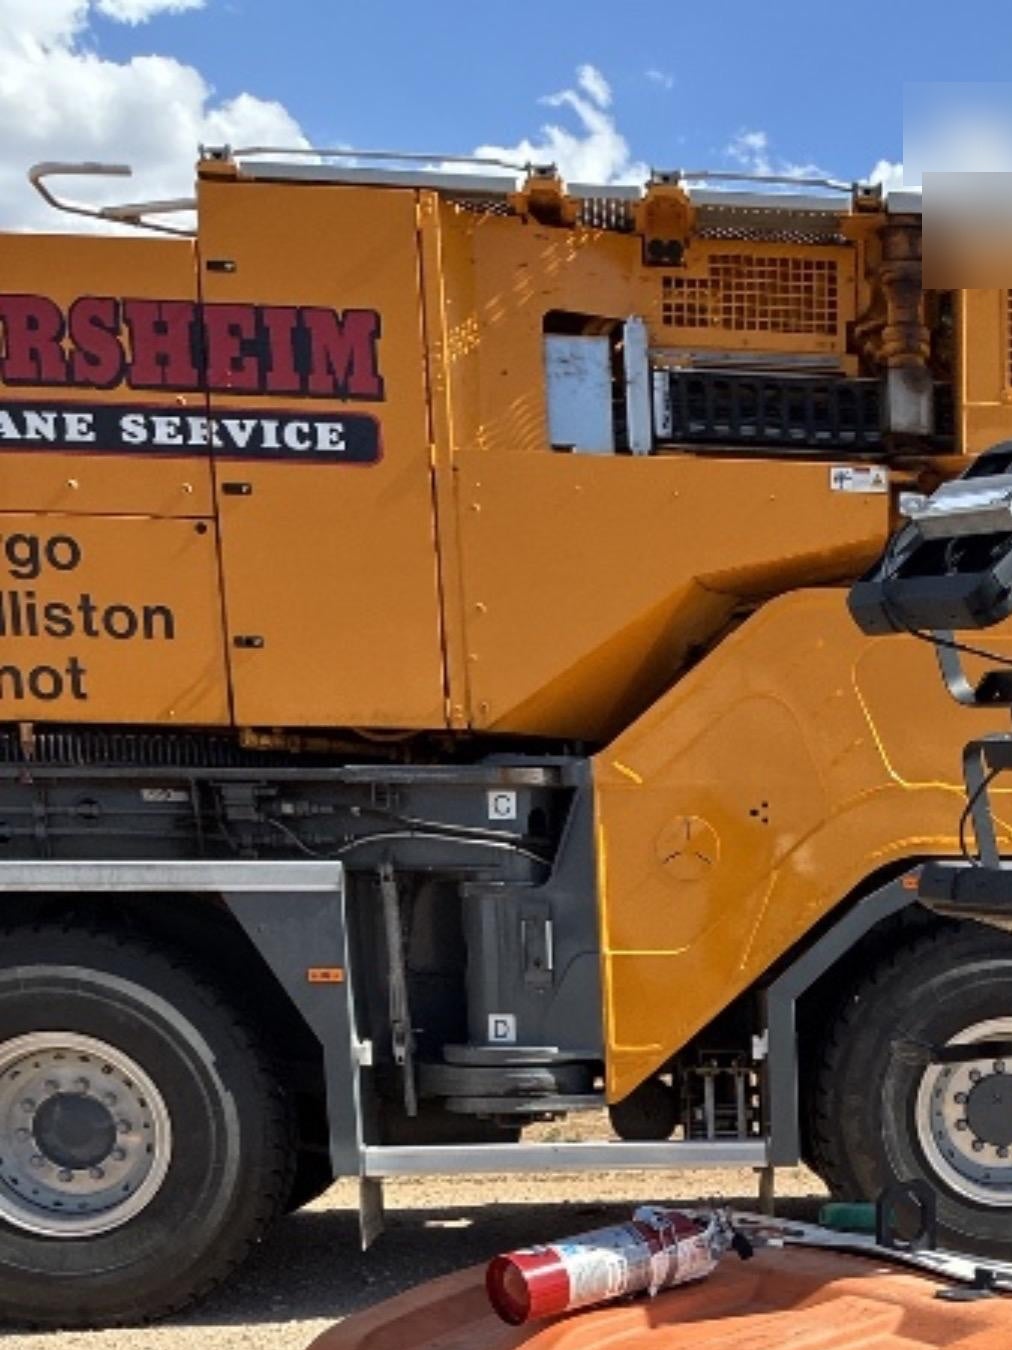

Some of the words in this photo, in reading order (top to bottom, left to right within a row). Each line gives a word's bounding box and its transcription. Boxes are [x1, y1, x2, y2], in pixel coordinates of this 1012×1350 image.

[120, 413, 346, 451] SERVICE
[0, 532, 82, 580] go
[494, 794, 511, 817] C
[494, 1018, 510, 1039] D
